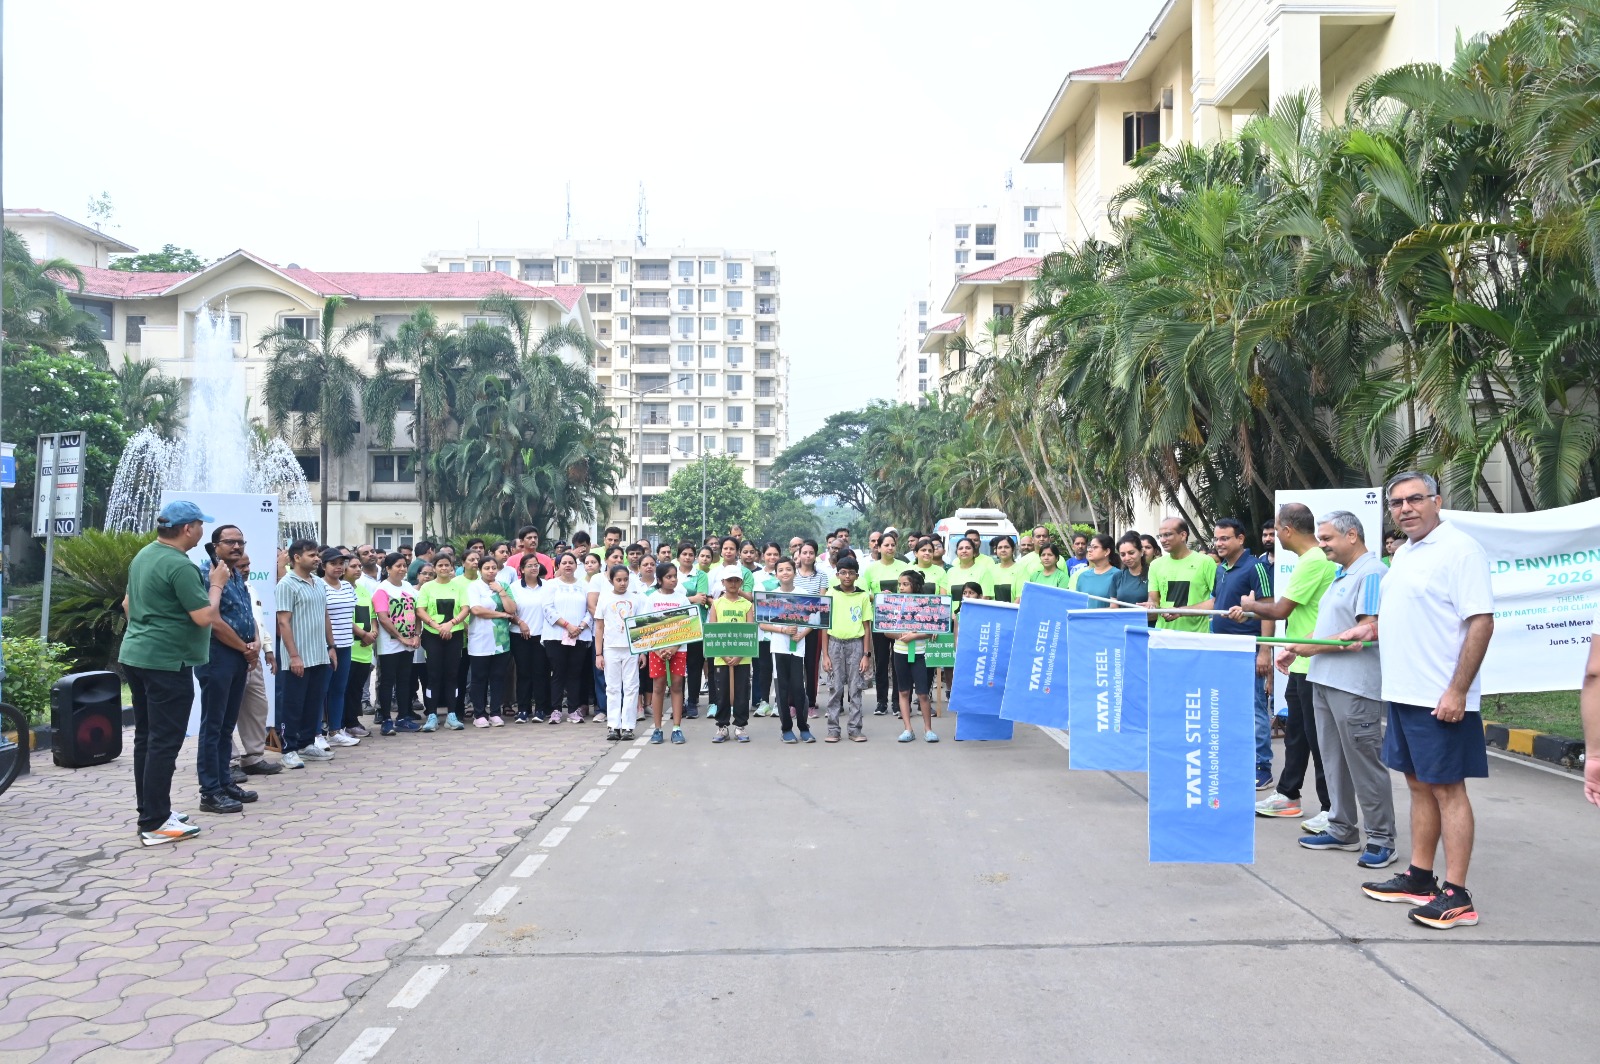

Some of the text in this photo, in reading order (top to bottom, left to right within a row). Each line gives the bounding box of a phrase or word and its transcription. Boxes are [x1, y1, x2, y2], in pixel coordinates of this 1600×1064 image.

[249, 571, 270, 581] DAY
[1546, 569, 1593, 586] 2026
[1557, 594, 1585, 604] THEME
[1502, 610, 1513, 618] BY
[1552, 605, 1569, 613] FOR
[1546, 621, 1567, 629] Steel
[1549, 638, 1570, 646] June
[1571, 637, 1579, 645] 5,
[974, 621, 991, 687] TATA STEEL
[1028, 619, 1051, 691] TATA STEEL
[1095, 648, 1109, 733] TATA STEEL
[1185, 687, 1202, 809] TATA STEEL
